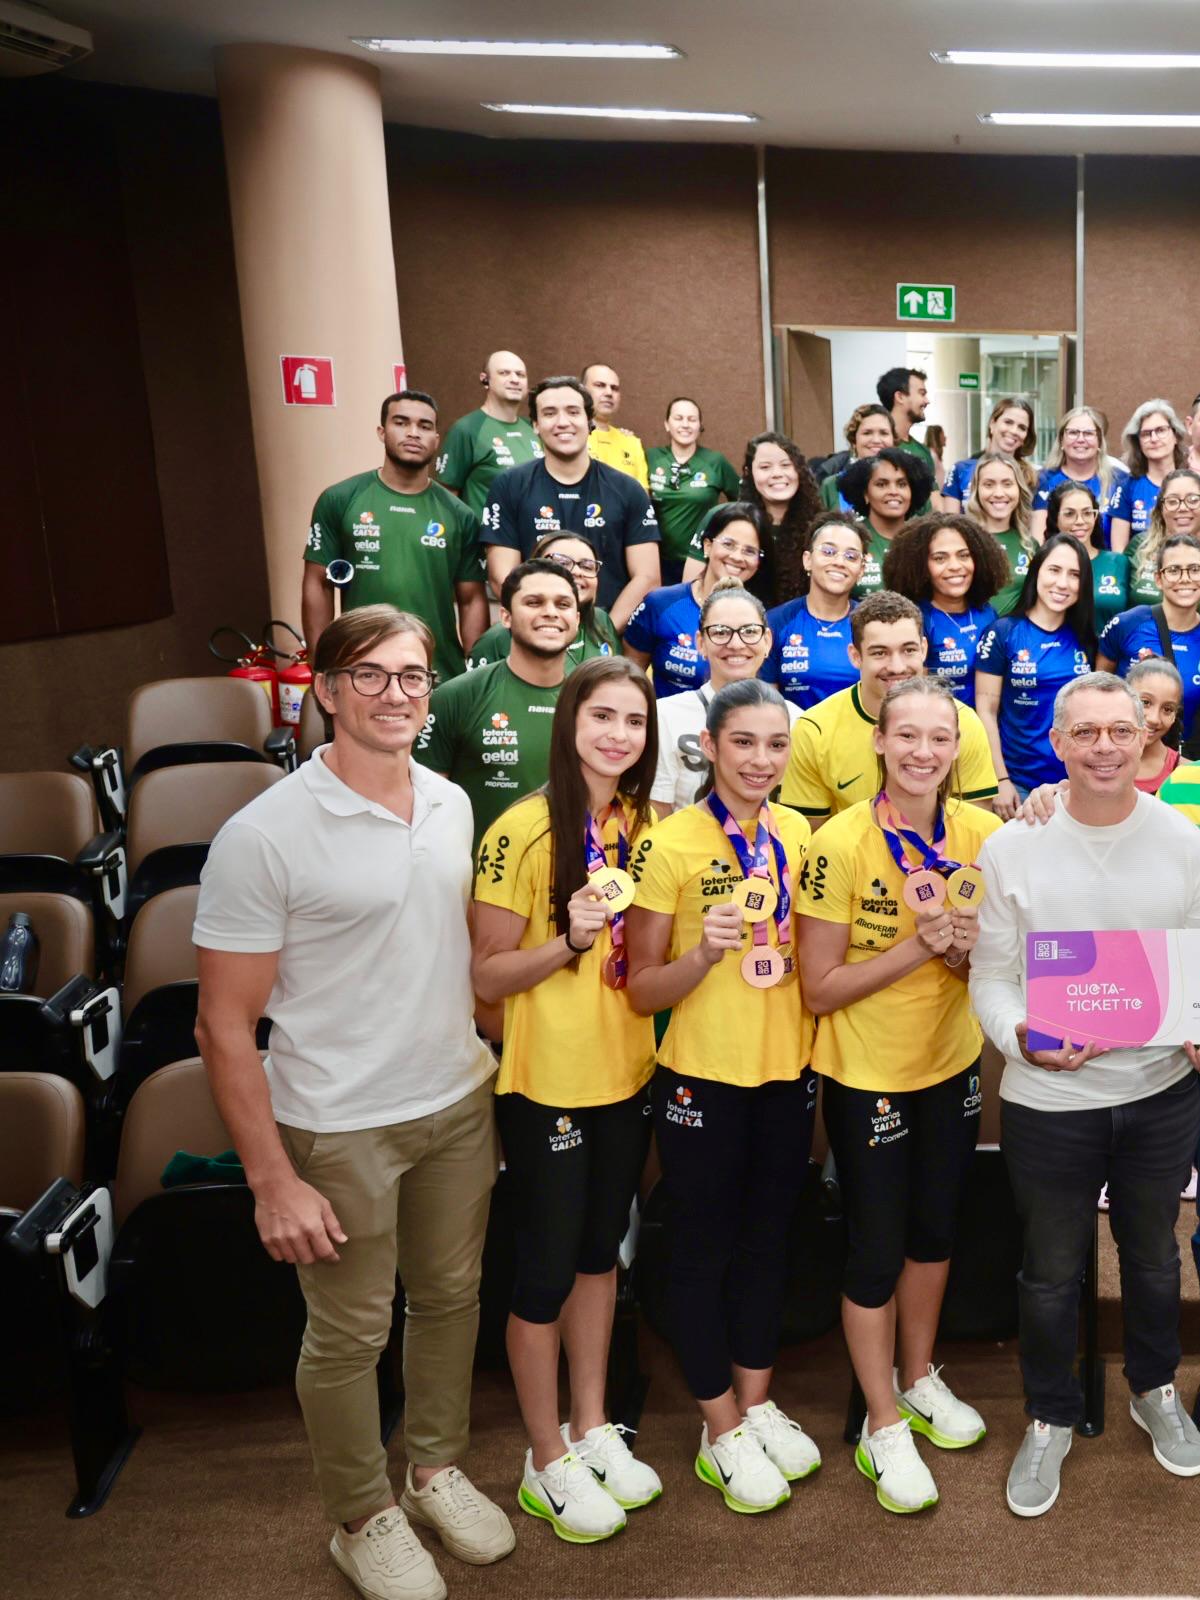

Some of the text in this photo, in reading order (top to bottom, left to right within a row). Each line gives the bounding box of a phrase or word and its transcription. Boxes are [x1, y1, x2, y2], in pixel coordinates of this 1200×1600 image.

[491, 503, 501, 530] vivo
[313, 523, 322, 551] vivo
[420, 536, 446, 548] CBG
[1100, 616, 1120, 638] vivo
[980, 630, 996, 659] vivo
[664, 660, 697, 676] gelol
[781, 660, 809, 673] gelol
[417, 713, 436, 749] vivo
[482, 728, 518, 737] loterias
[482, 736, 518, 745] CAIXA
[482, 749, 519, 764] gelol
[492, 835, 510, 884] vivo
[630, 839, 653, 883] vivo
[701, 873, 745, 886] loterias
[812, 855, 828, 901] vivo
[854, 917, 898, 934] ATROVERAN
[1067, 983, 1125, 995] QUOTA-
[1067, 998, 1142, 1012] TICKET TO
[667, 1099, 703, 1118] loterias
[665, 1111, 703, 1128] CAIXA
[871, 1111, 900, 1125] loterias
[874, 1118, 902, 1133] CAIXA
[549, 1128, 581, 1144] loterias
[551, 1136, 583, 1151] CAIXA
